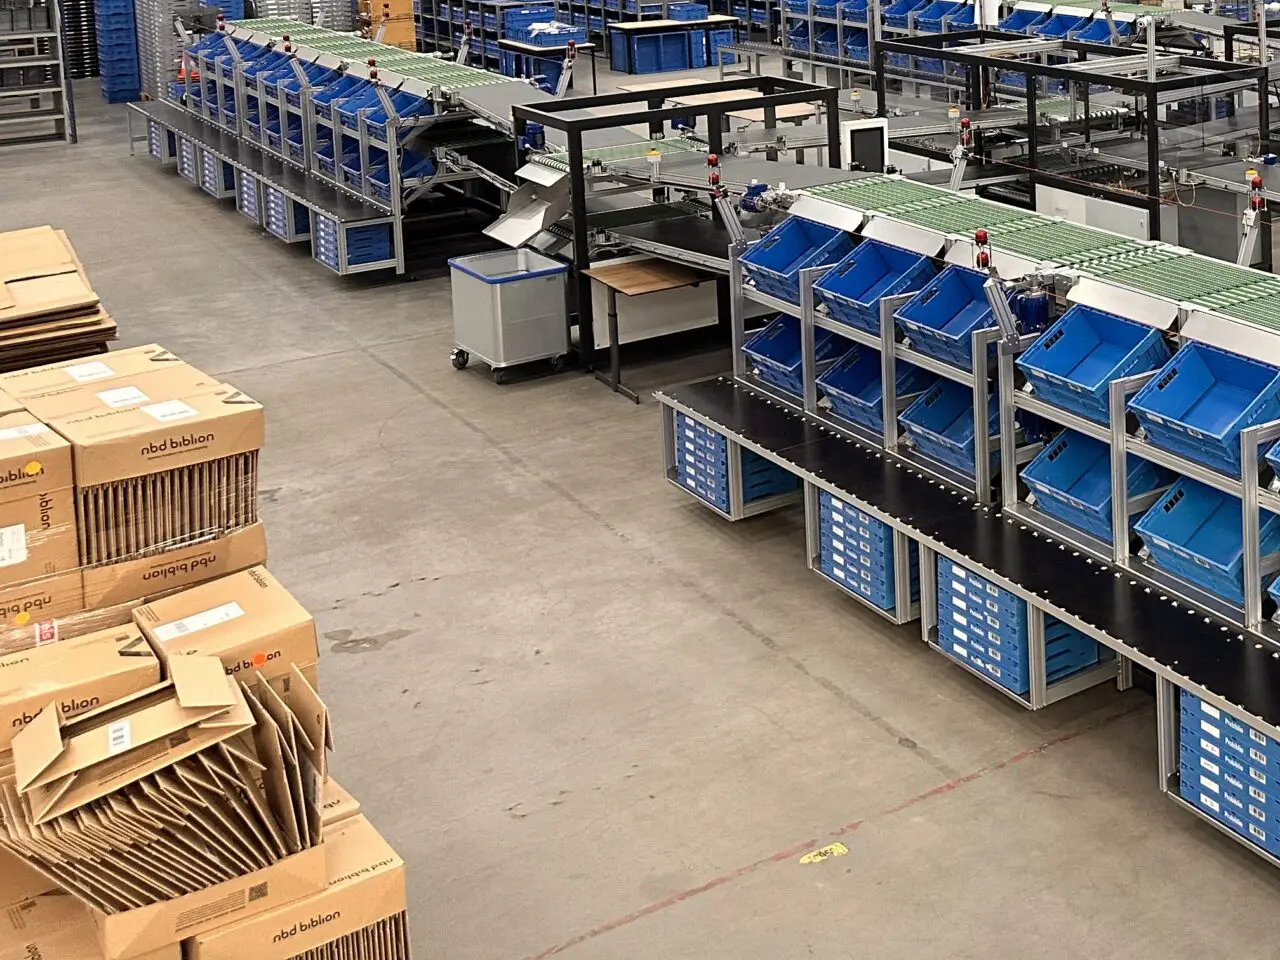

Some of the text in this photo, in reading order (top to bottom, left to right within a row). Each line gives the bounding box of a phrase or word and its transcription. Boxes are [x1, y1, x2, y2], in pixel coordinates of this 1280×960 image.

[141, 440, 168, 456] nbd
[170, 433, 215, 449] biblion
[142, 563, 188, 581] biblion
[191, 555, 216, 577] nbd
[225, 662, 241, 676] bd
[272, 911, 341, 944] nbd biblion
